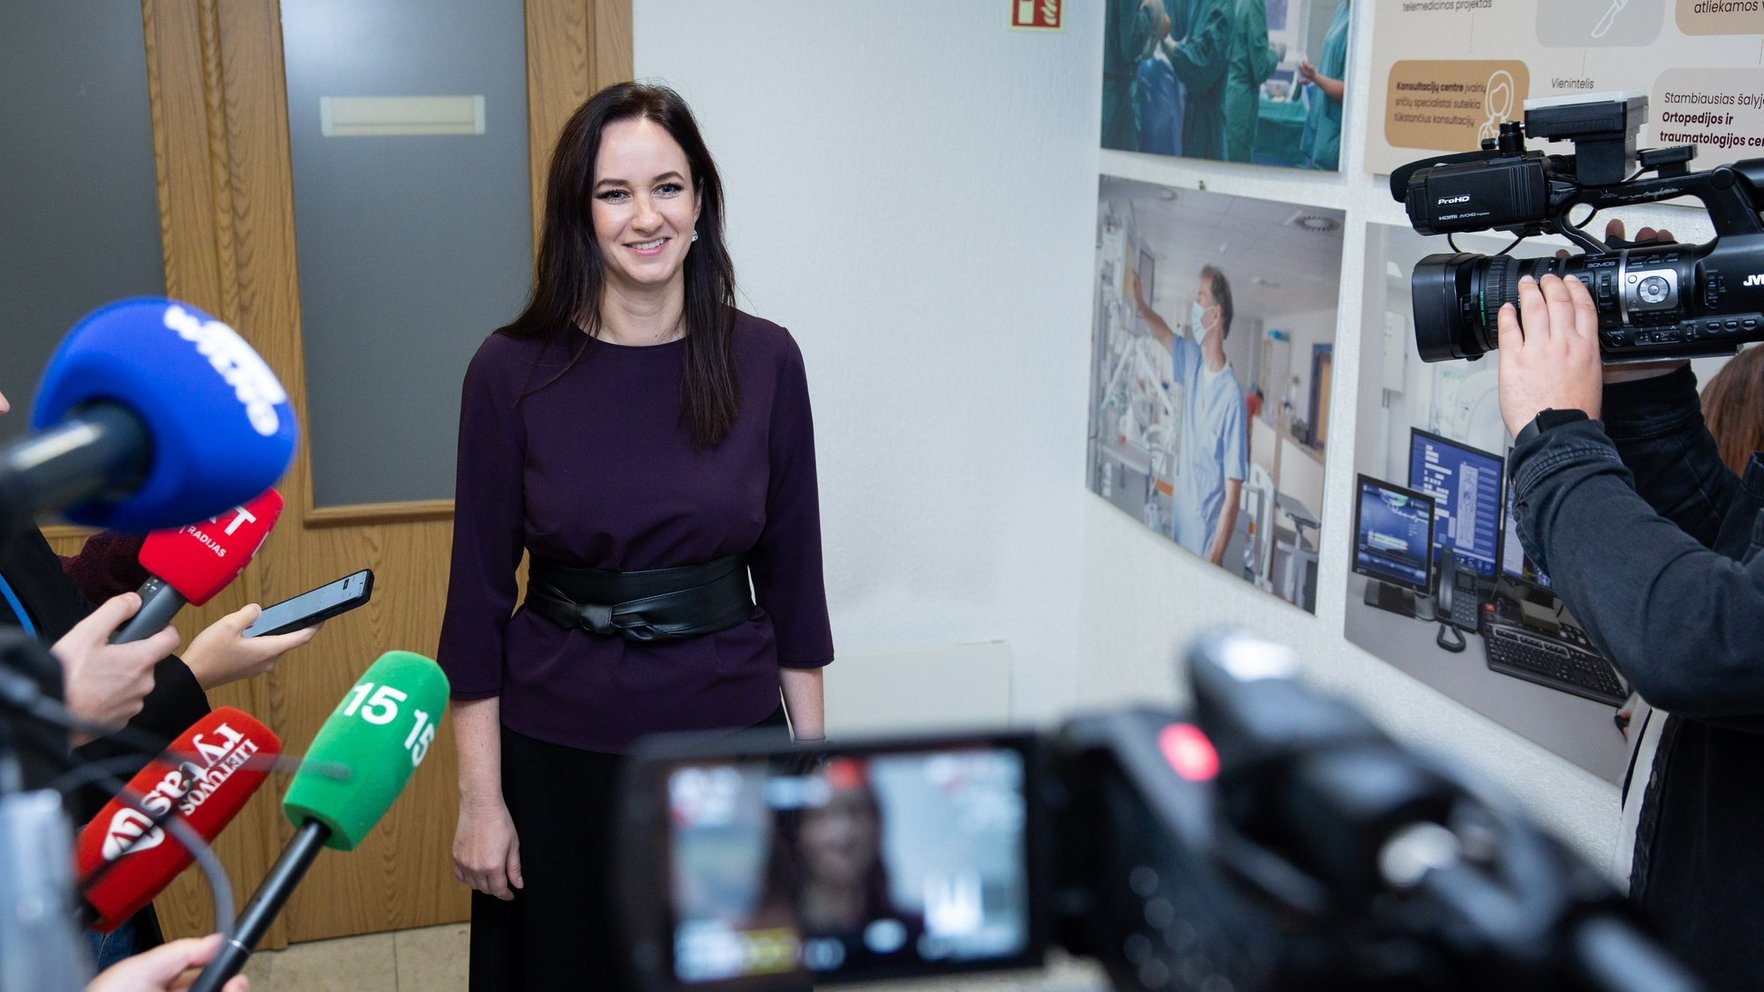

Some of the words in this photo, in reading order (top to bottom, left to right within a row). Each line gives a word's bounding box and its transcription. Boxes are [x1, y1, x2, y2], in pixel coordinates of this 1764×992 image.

[1455, 0, 1492, 12] projektas
[1694, 0, 1759, 14] atliekamos
[1440, 84, 1464, 93] centre
[1551, 78, 1595, 89] Vienintelis
[1664, 91, 1735, 105] Stambiausias
[1737, 92, 1764, 110] šalyj
[1661, 111, 1723, 128] Ortopedijos
[1725, 112, 1734, 125] ir
[1659, 130, 1746, 149] traumatologijos
[1437, 195, 1470, 205] ProHD
[187, 525, 227, 558] RADIJAS
[343, 681, 408, 726] 15
[404, 708, 435, 768] 15
[140, 722, 245, 817] rytas
[178, 738, 259, 817] LIETUVOS
